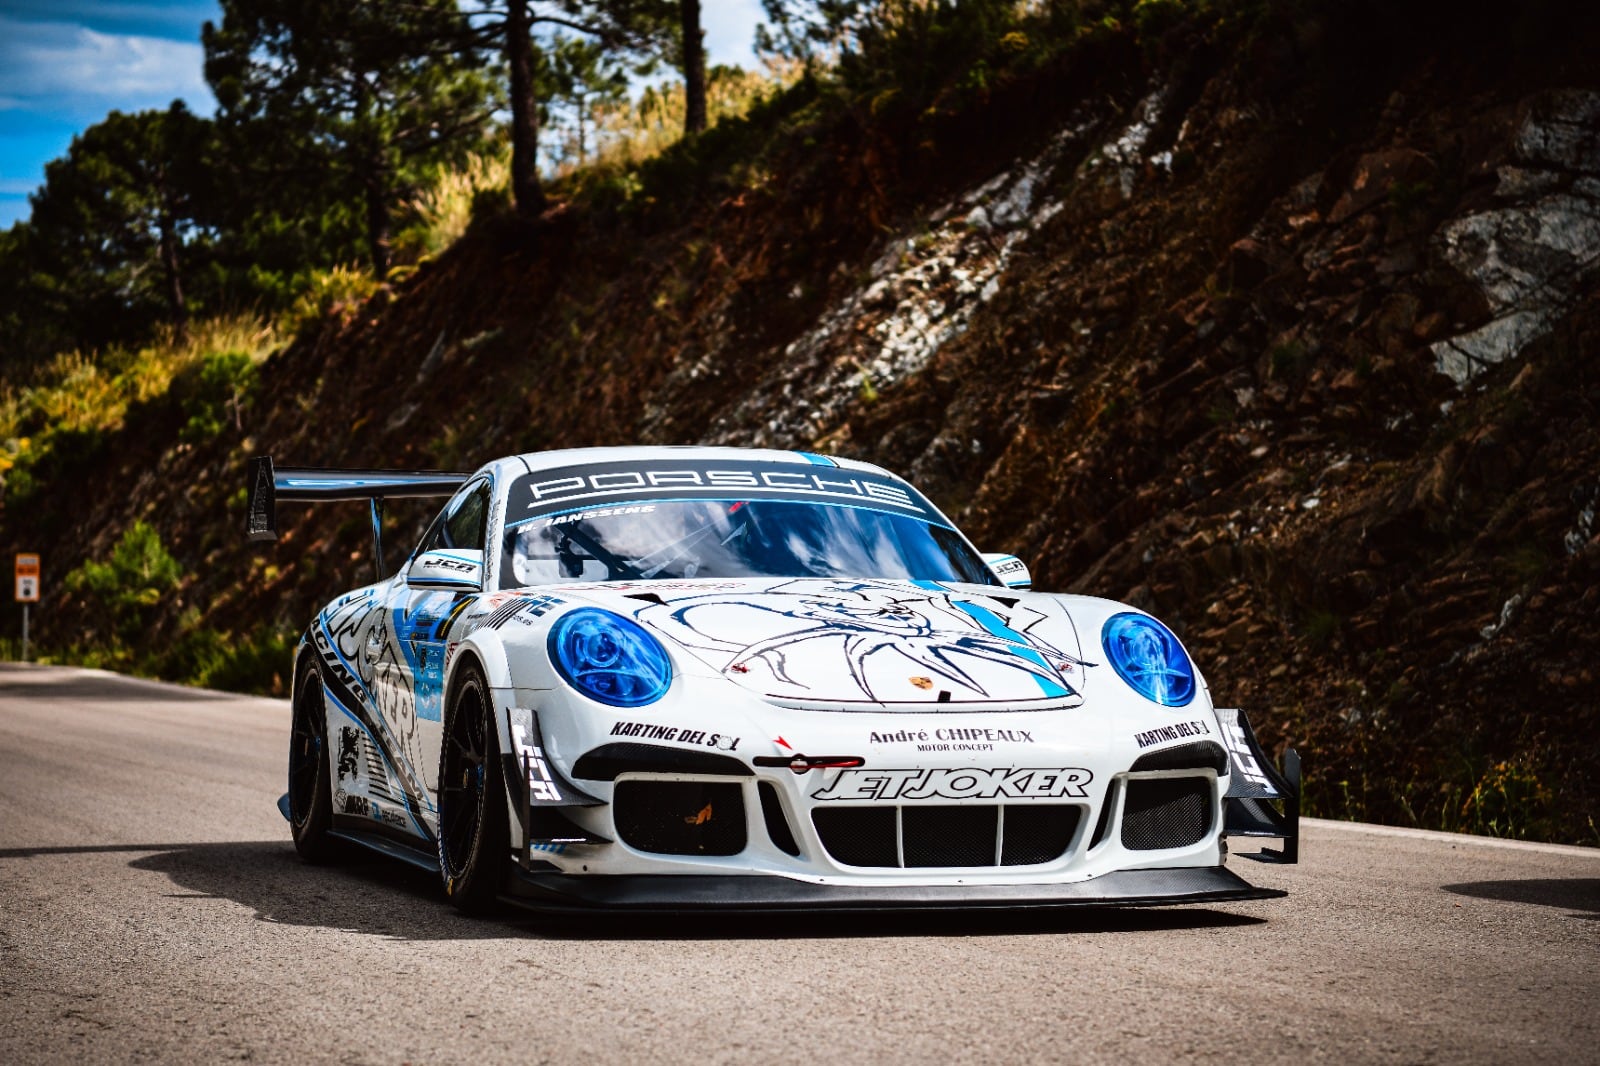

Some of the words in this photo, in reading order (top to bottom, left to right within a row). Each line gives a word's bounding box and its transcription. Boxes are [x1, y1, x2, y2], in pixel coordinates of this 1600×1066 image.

[529, 471, 914, 505] PORSCHE
[544, 505, 656, 527] JANSSENS
[311, 618, 368, 704] ACING
[610, 721, 678, 741] KARTING
[677, 729, 706, 745] DEL
[869, 729, 929, 744] André
[935, 728, 1035, 744] CHIPEAUX
[1134, 726, 1179, 748] KARTING
[1174, 722, 1194, 738] DEL
[917, 744, 950, 752] MOTOR
[952, 743, 994, 752] CONCEPT
[811, 767, 1094, 801] JETJOKER
